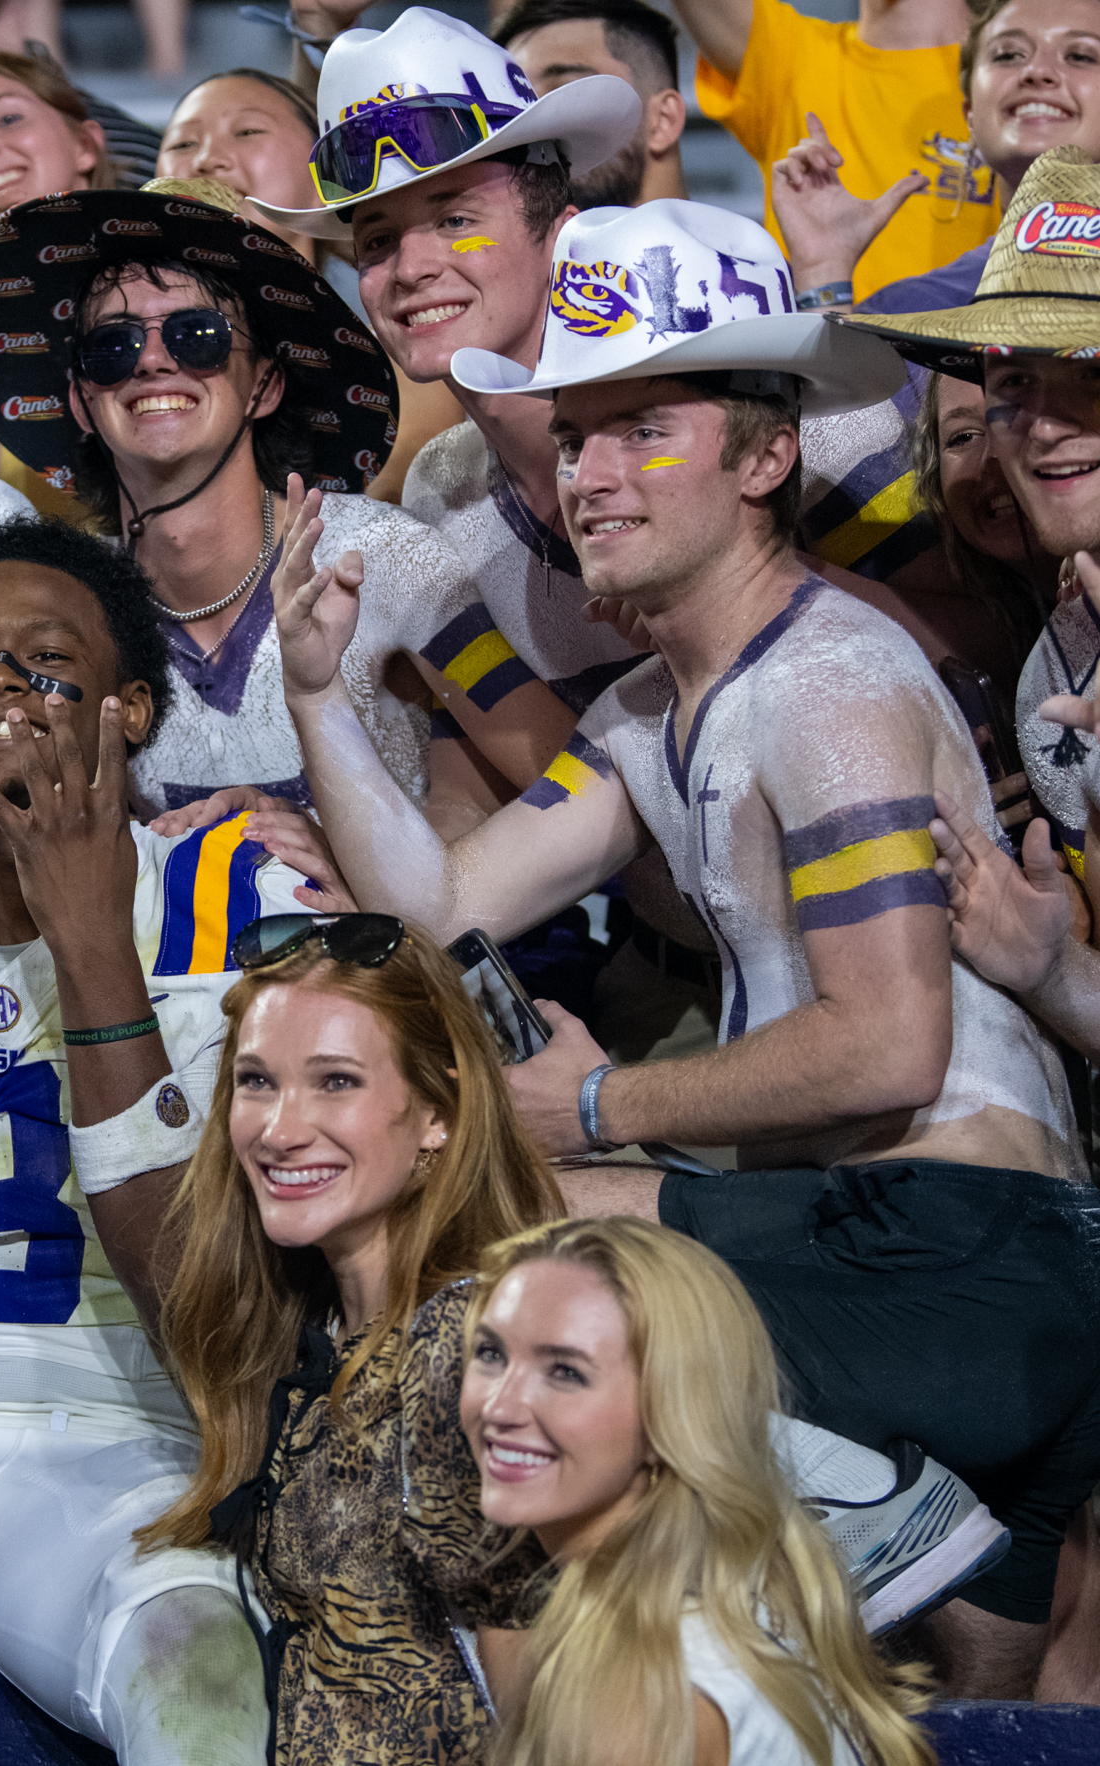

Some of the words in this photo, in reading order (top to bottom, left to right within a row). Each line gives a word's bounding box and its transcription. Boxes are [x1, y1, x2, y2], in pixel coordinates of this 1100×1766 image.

[1055, 203, 1095, 217] Raising
[102, 218, 161, 235] Cane's
[38, 243, 97, 264] Cane's
[3, 395, 62, 421] Cane's
[64, 1031, 98, 1041] owered
[101, 1030, 115, 1041] by
